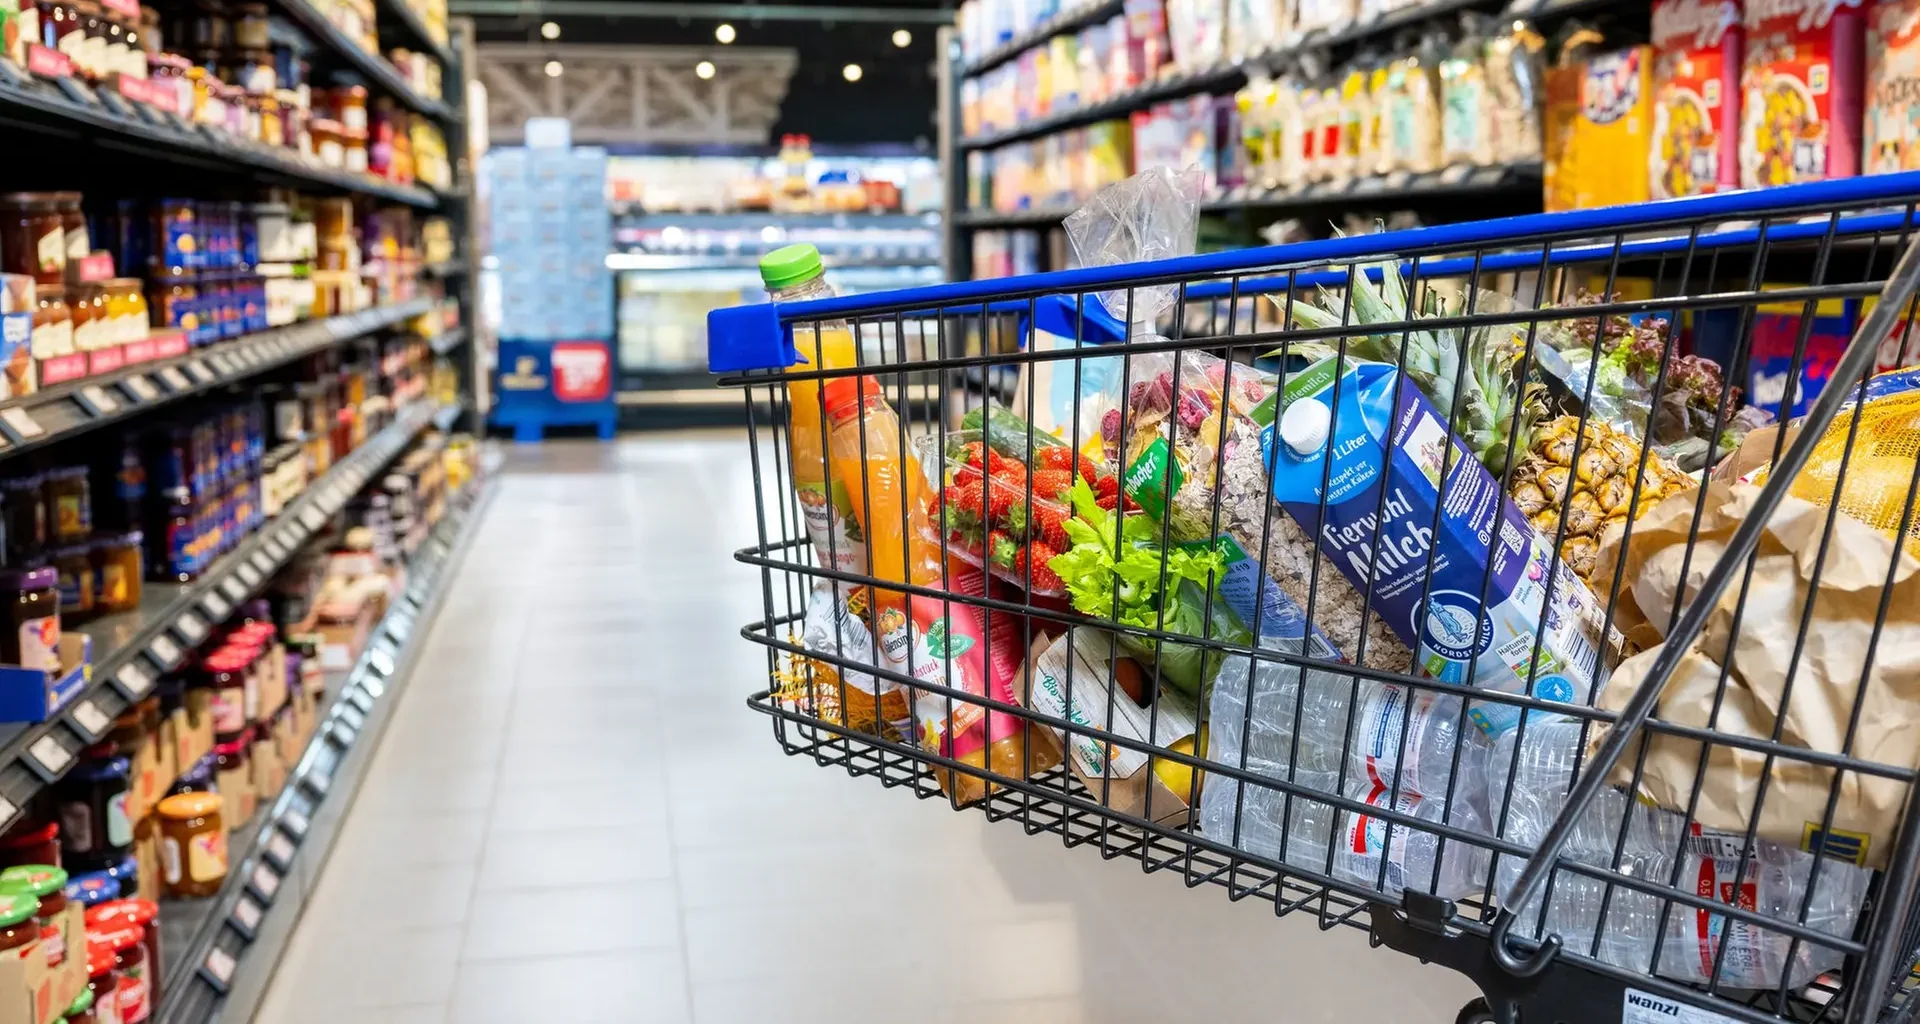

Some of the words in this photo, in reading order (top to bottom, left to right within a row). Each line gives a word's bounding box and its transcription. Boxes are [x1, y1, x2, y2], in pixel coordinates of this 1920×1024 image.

[1528, 368, 1555, 408] EDKA
[1332, 447, 1342, 460] 1
[1340, 433, 1368, 457] Liter
[1433, 642, 1481, 659] NORDSE
[1479, 618, 1490, 648] MILCH
[1498, 633, 1531, 656] Haltungs-
[1511, 644, 1529, 658] form
[1391, 796, 1411, 838] MINRAL
[1727, 929, 1740, 967] WSSER
[1627, 993, 1680, 1017] wanzl
